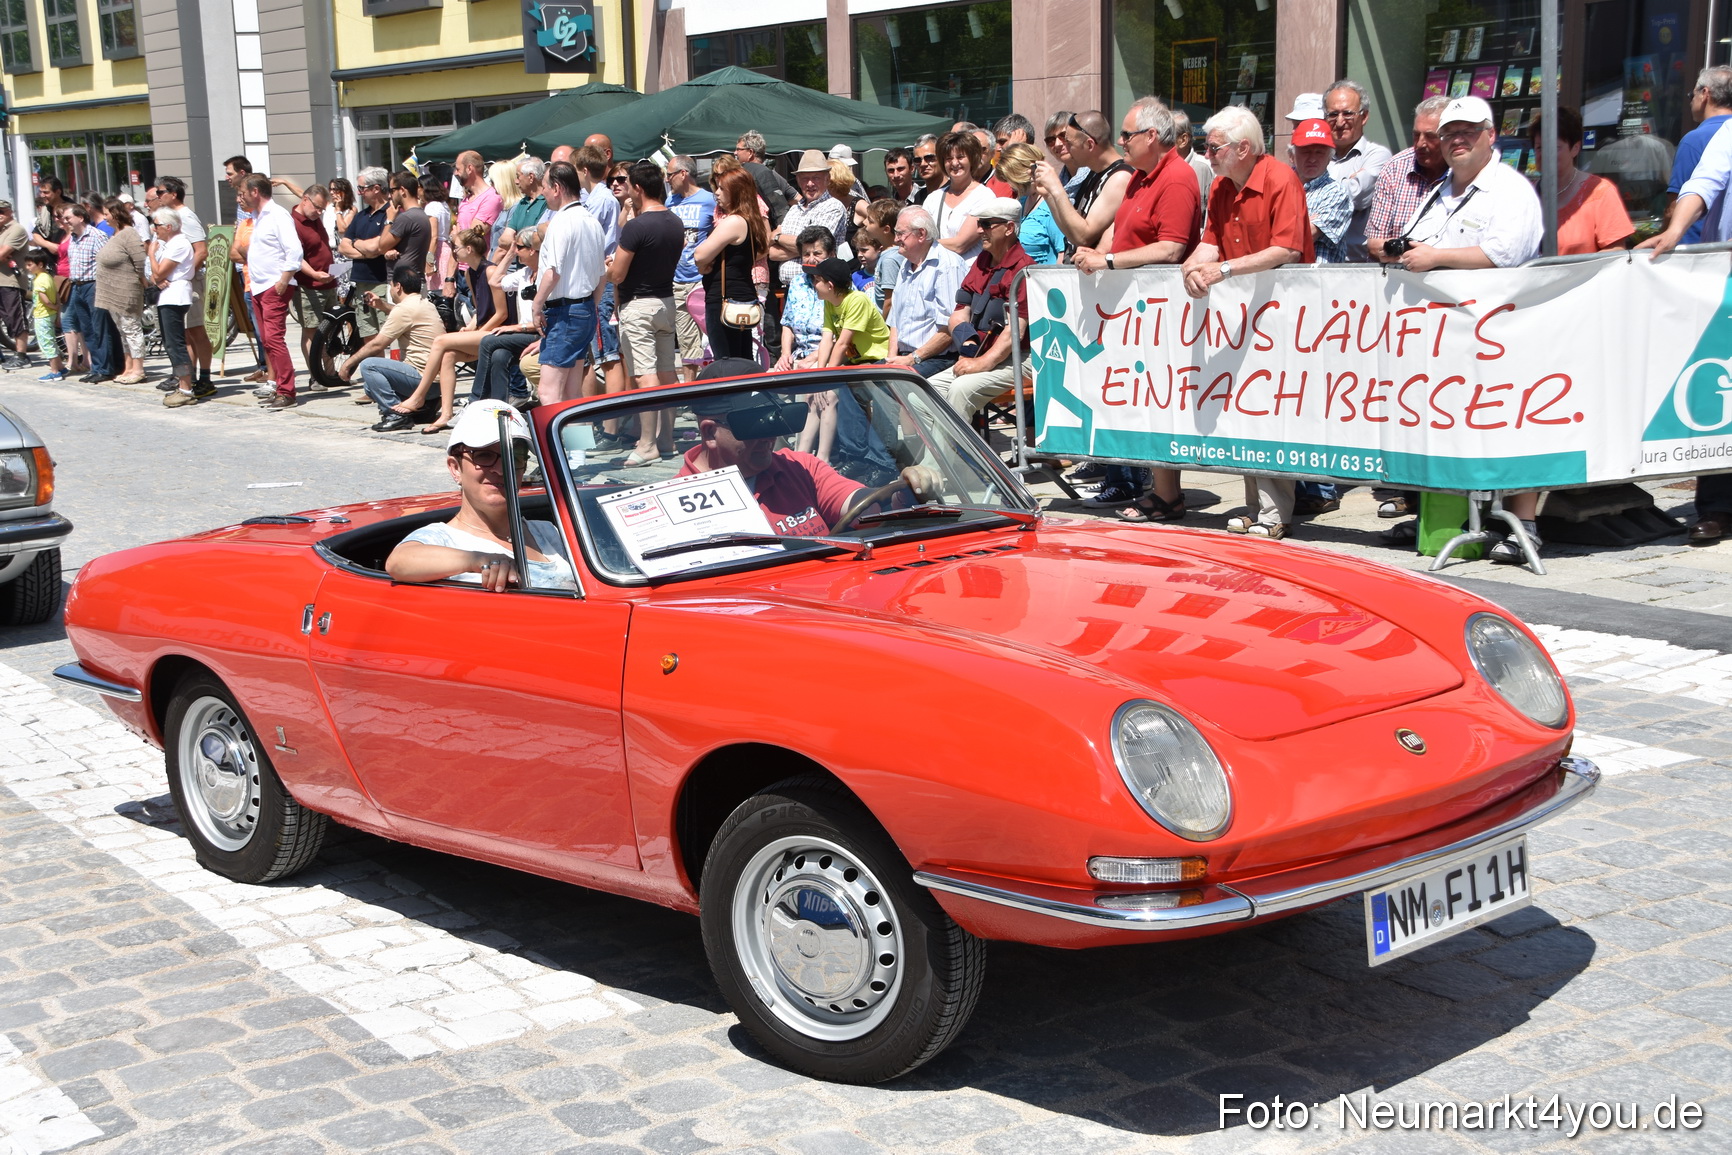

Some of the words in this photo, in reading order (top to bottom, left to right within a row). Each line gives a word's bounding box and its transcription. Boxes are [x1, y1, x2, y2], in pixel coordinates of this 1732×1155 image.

[553, 15, 578, 48] G2
[1182, 56, 1208, 69] WEBER'S
[1182, 68, 1207, 86] GRILL
[1182, 86, 1207, 104] BIBEL
[1180, 300, 1280, 352] UNS
[1324, 371, 1585, 430] BESSER.
[1170, 440, 1271, 464] Service-Line:
[1640, 449, 1667, 464] Jura
[678, 489, 725, 514] 521
[776, 506, 818, 533] 1852
[1388, 882, 1429, 942] NM
[1376, 930, 1385, 944] D
